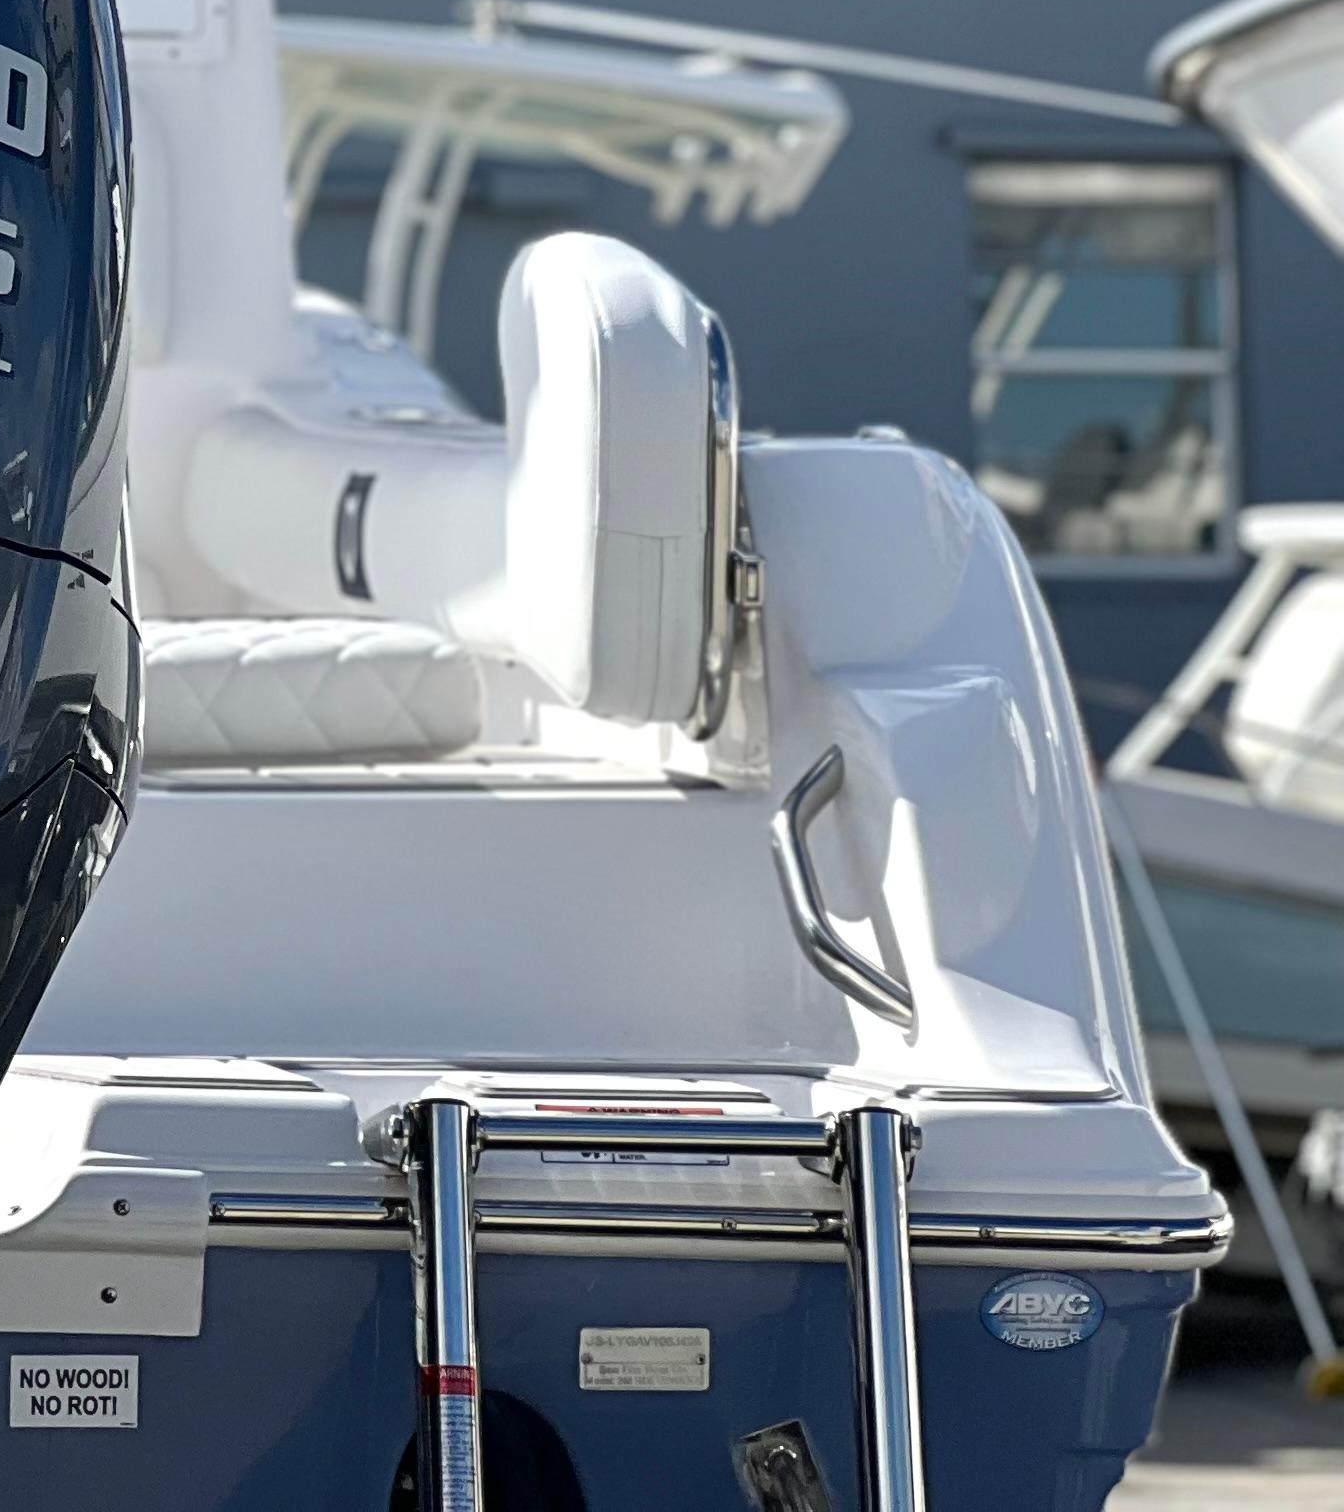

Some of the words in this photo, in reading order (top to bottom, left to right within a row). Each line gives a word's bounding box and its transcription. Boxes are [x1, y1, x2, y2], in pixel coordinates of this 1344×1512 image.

[988, 1293, 1091, 1316] ABYC
[1000, 1330, 1083, 1351] MEMBER
[19, 1368, 50, 1389] NO
[30, 1395, 62, 1416] NO
